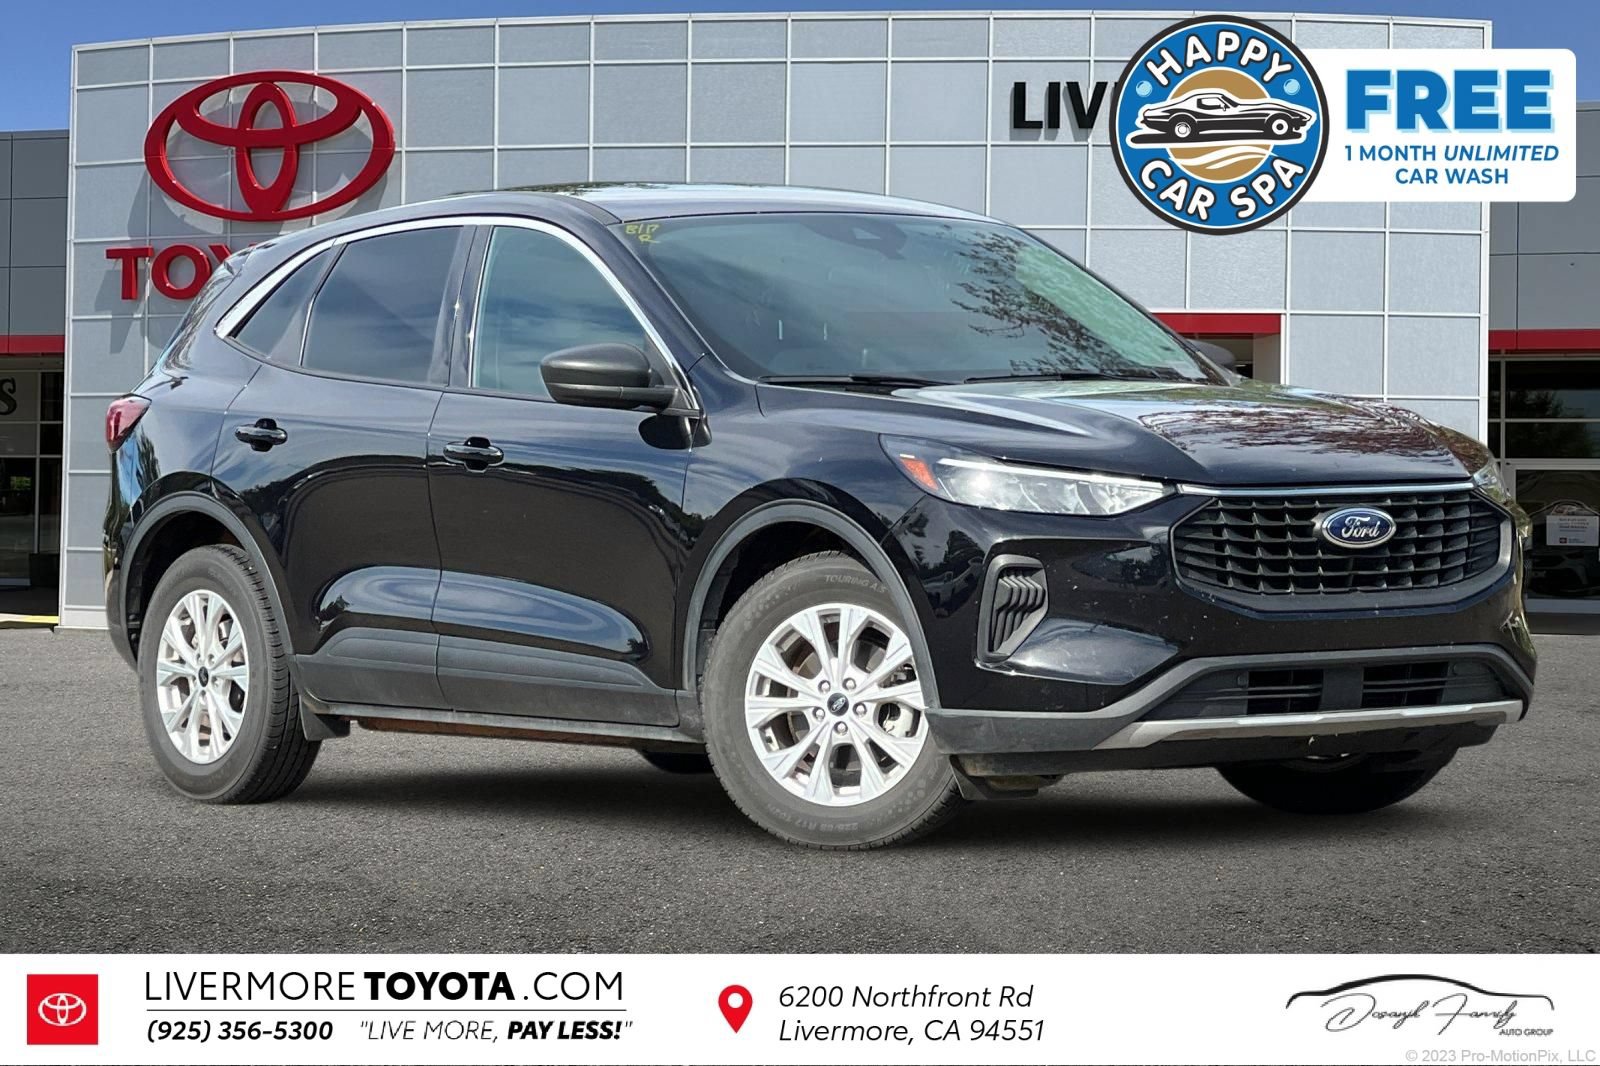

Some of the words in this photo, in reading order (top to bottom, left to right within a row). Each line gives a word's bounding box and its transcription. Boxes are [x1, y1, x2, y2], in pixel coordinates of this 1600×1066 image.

[1013, 81, 1119, 129] LIV
[1341, 516, 1381, 538] Ford
[824, 574, 870, 587] TOURING
